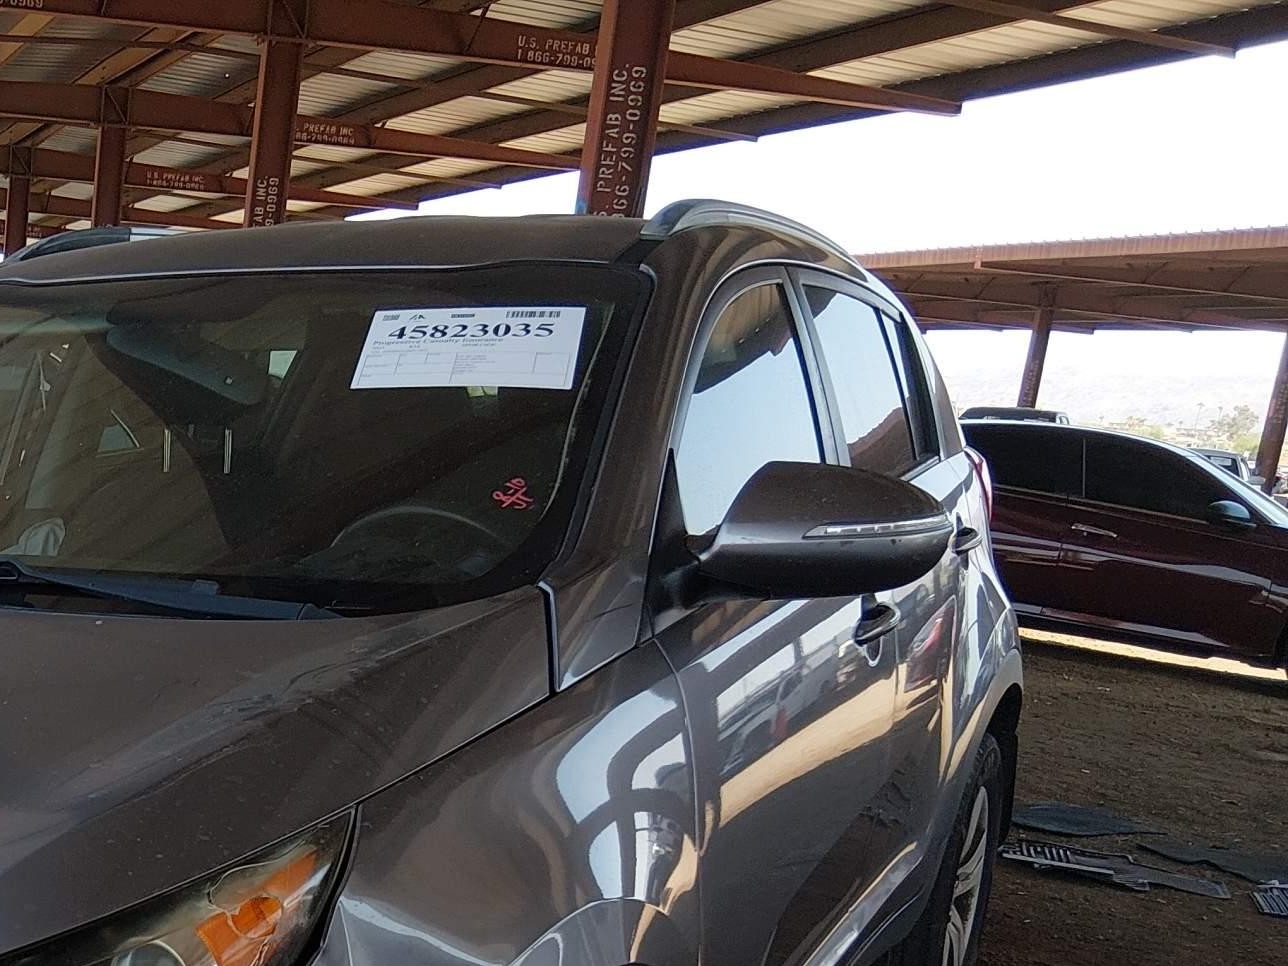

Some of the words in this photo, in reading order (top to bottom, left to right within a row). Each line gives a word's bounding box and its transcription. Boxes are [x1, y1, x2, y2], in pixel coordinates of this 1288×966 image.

[518, 35, 539, 49] U.S.
[545, 39, 590, 55] PREFAB
[609, 63, 630, 101] INC.
[597, 113, 622, 192] PREFAB
[255, 175, 268, 201] INC.
[388, 322, 556, 340] 45823035
